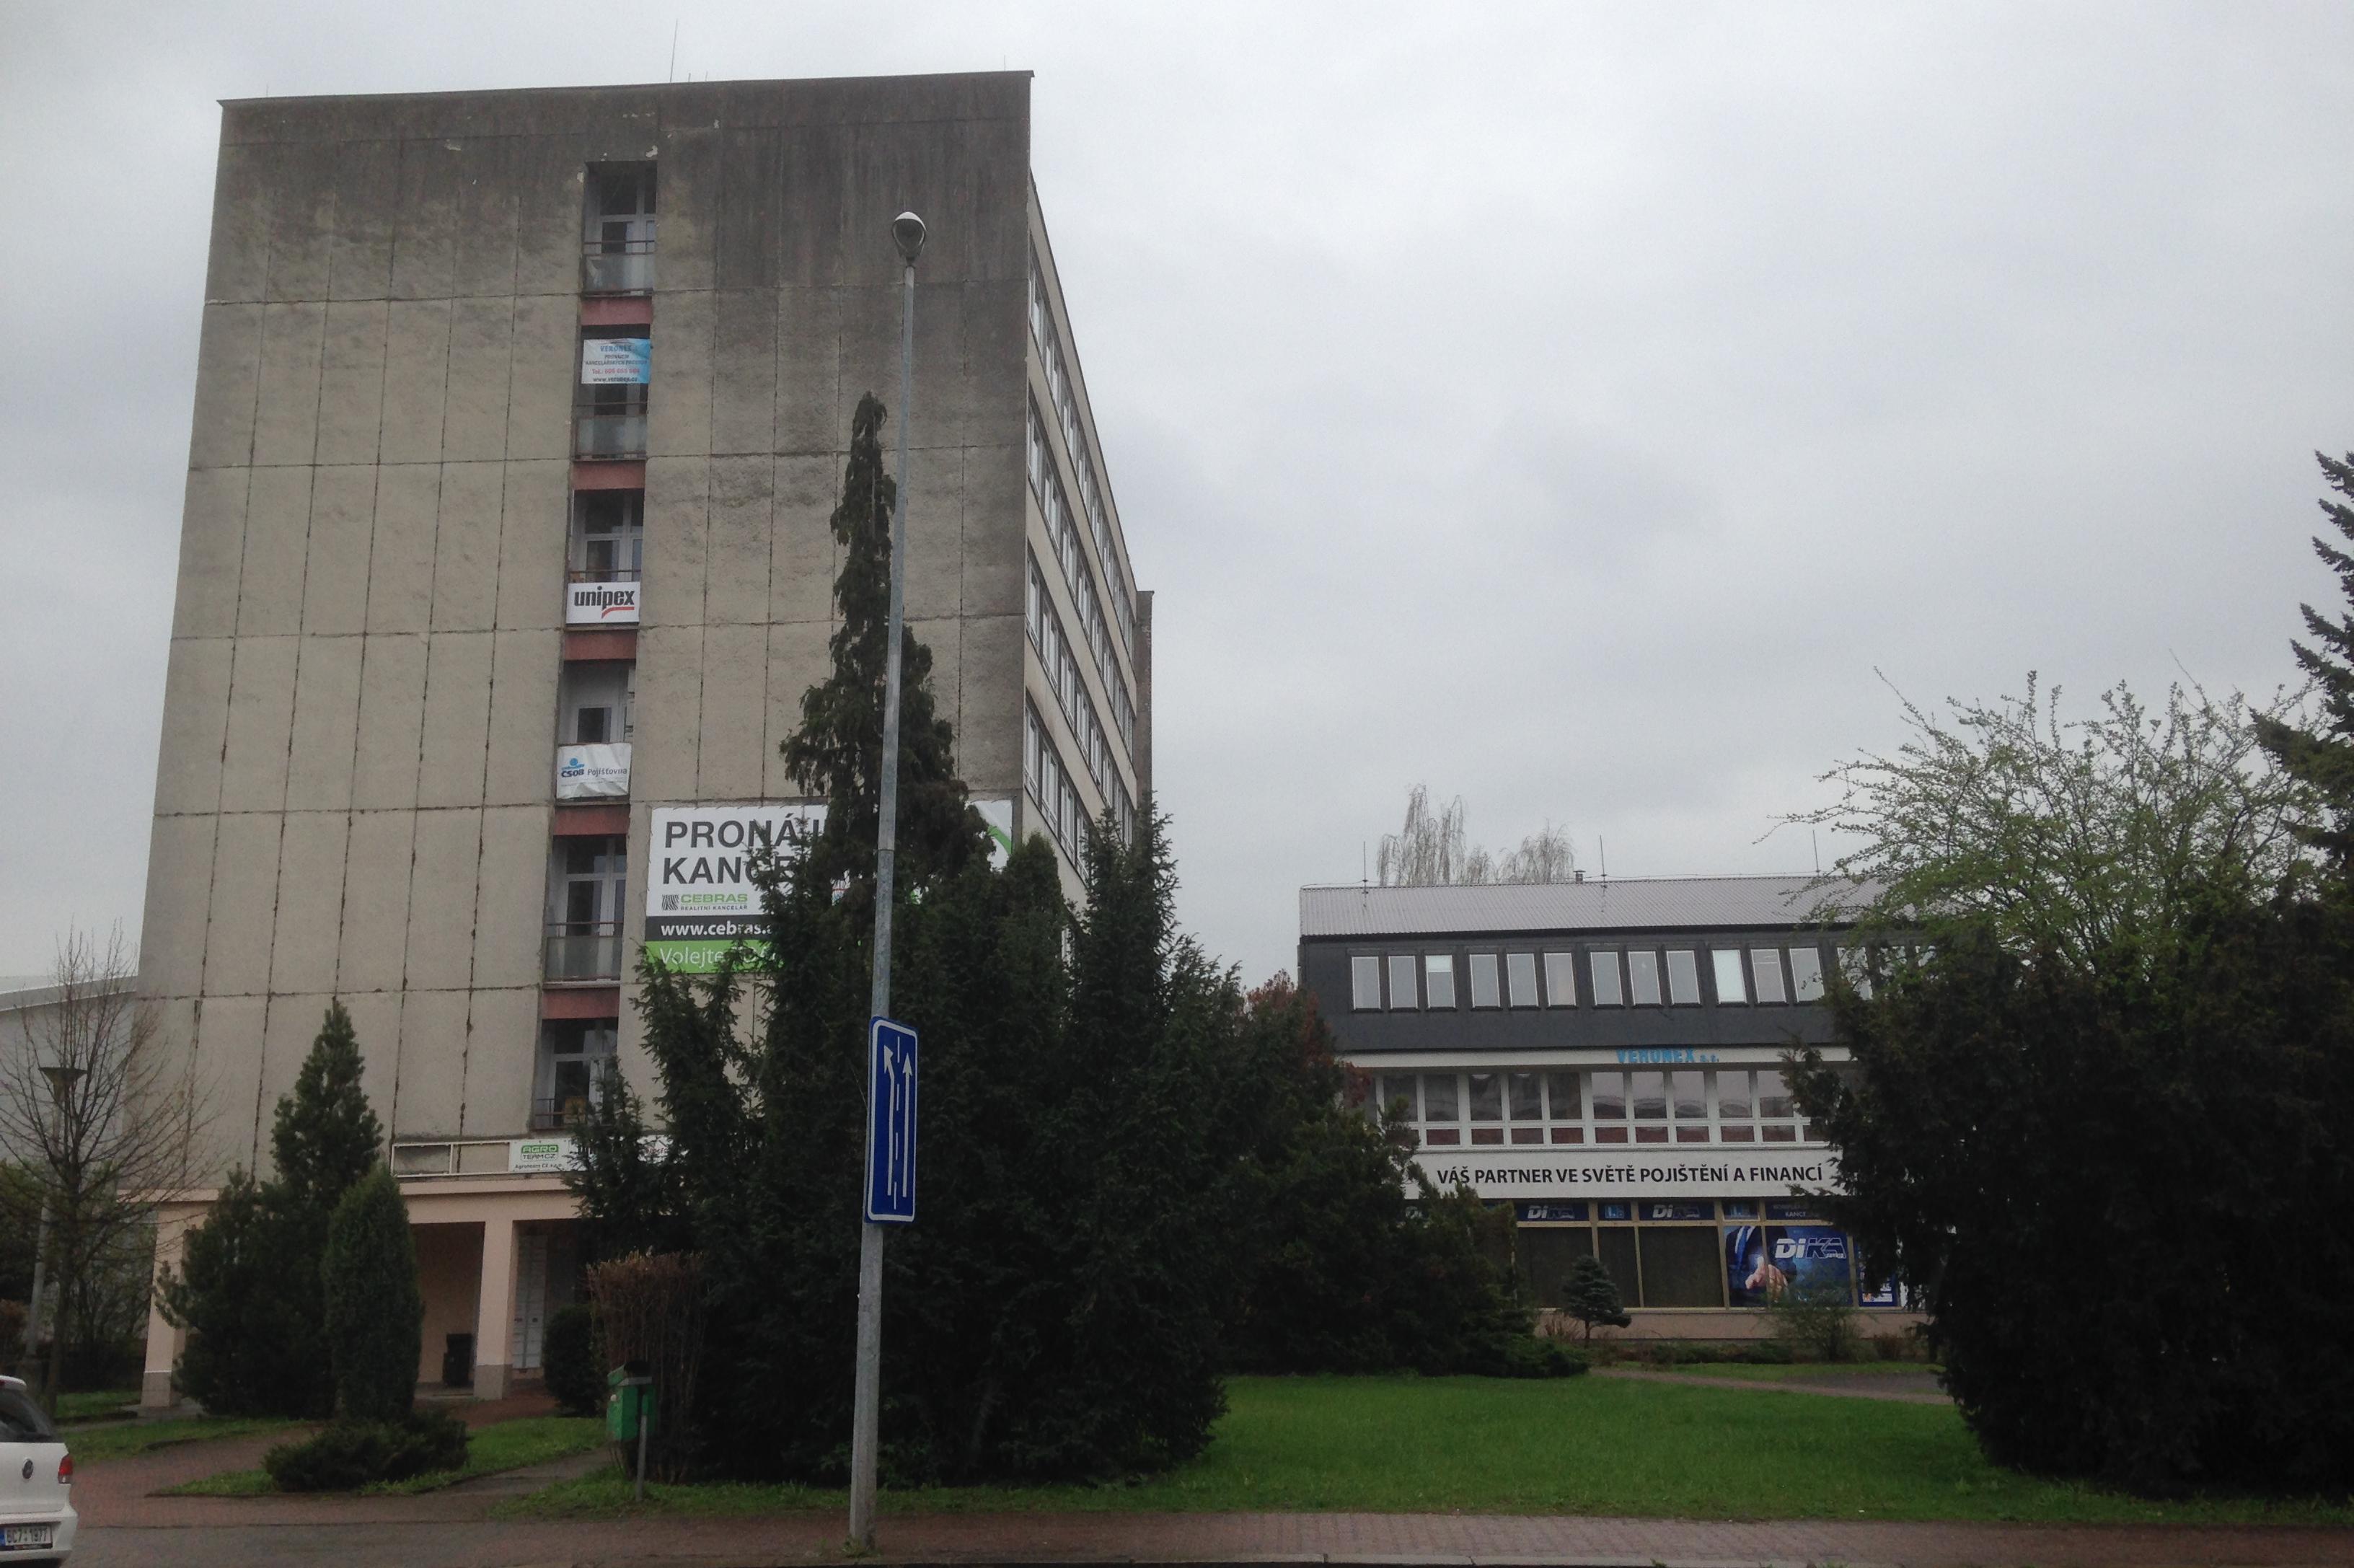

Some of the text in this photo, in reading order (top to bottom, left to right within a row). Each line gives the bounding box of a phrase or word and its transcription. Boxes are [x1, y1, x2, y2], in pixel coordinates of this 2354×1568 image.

[574, 586, 635, 611] unipex
[680, 894, 748, 903] CEBRAS
[659, 947, 724, 969] Volejte
[1437, 1163, 1822, 1184] VÁŠ PARTNER VE SVĚTĚ POJIŠTĚNÍ A FINANCÍ
